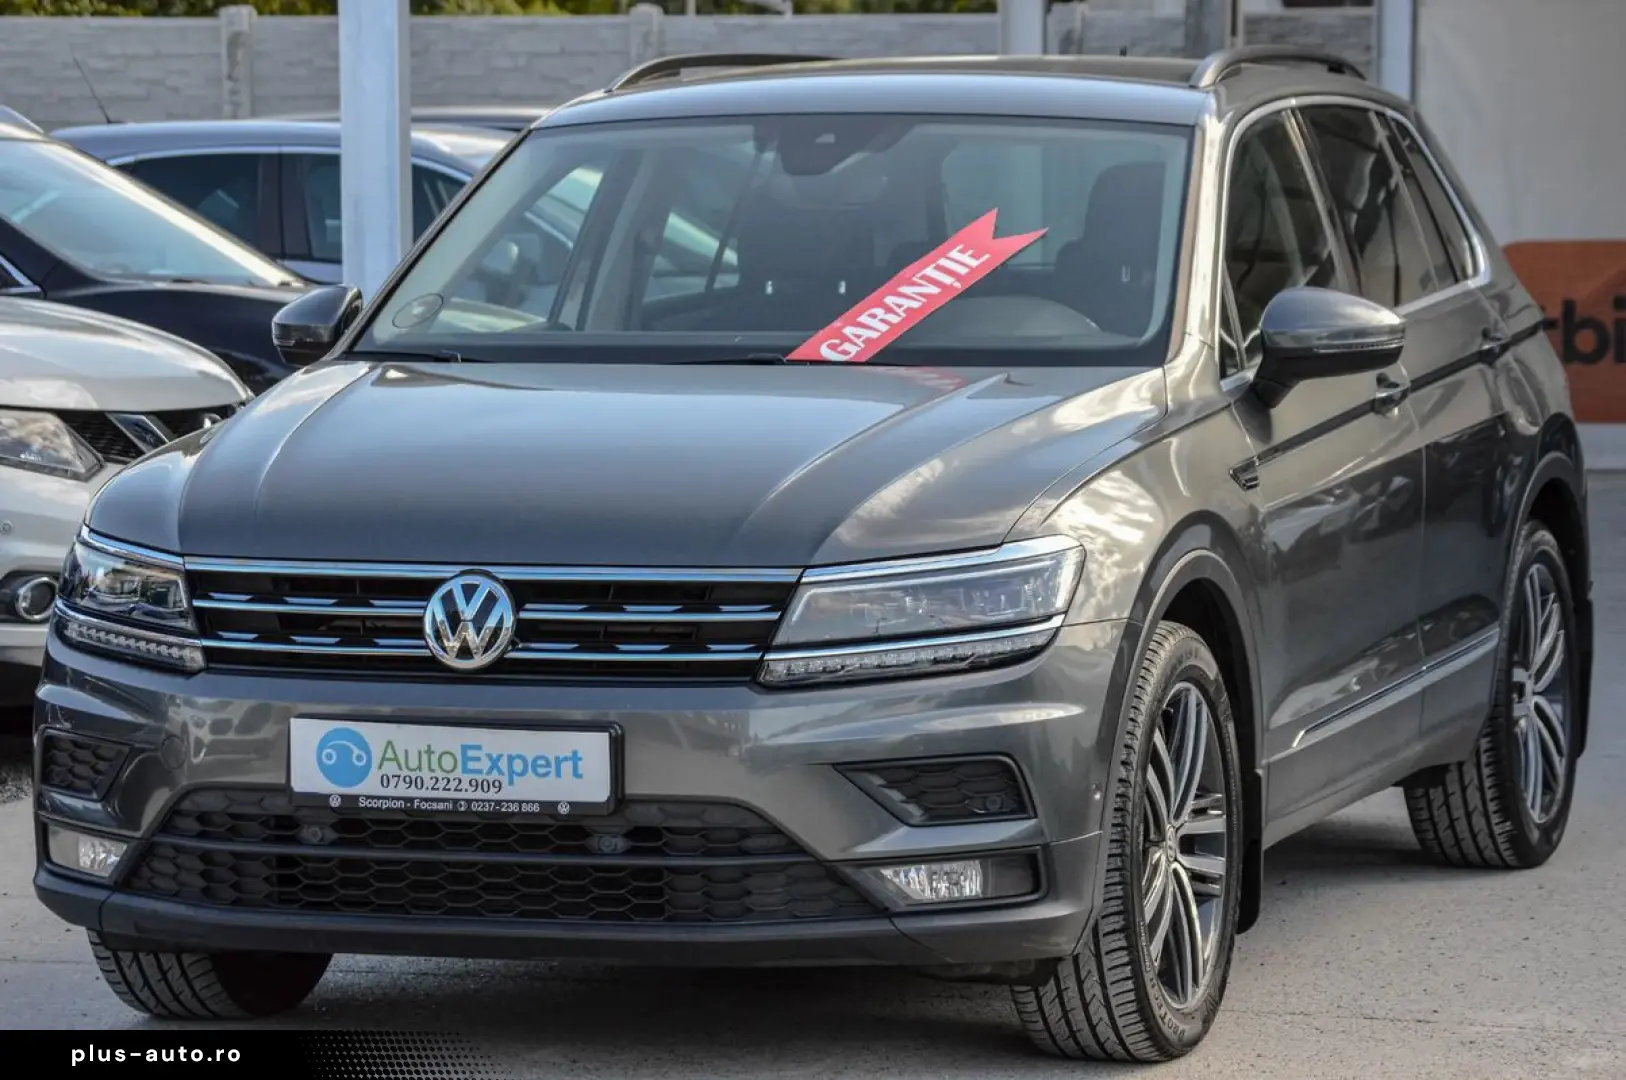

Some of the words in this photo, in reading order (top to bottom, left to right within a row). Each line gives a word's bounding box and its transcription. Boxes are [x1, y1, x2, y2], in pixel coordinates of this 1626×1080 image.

[378, 740, 584, 786] AutoExpert
[380, 774, 503, 794] 0790.222.909
[358, 796, 405, 810] Scorpion
